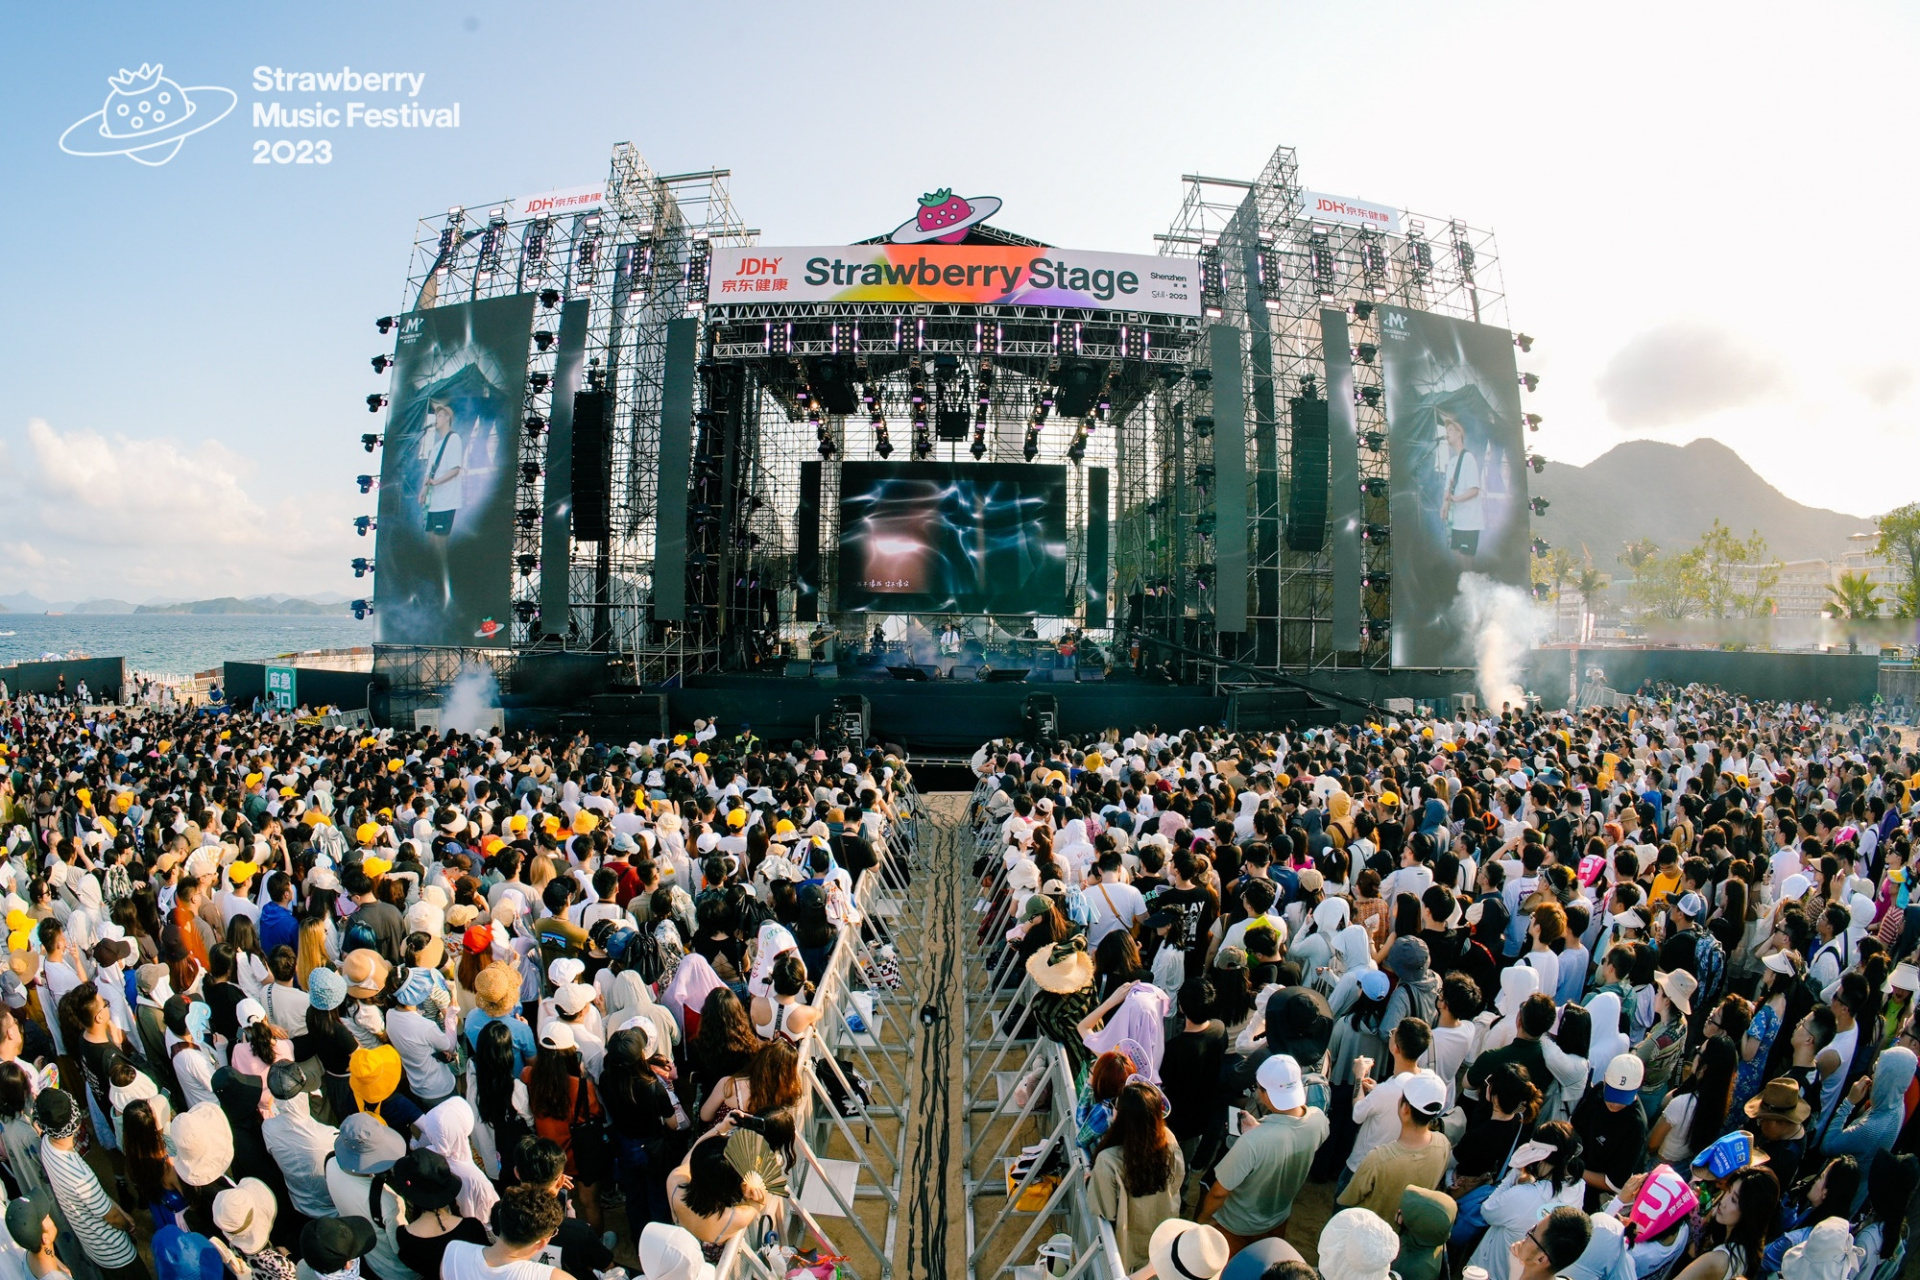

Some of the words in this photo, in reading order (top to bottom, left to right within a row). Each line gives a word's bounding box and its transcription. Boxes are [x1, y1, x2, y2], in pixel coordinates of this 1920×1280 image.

[525, 197, 555, 213] JDH
[555, 192, 602, 208] 京东健康
[1316, 198, 1346, 215] JDH
[1347, 206, 1390, 223] 京东健康
[736, 257, 783, 276] JDH
[804, 257, 1022, 294] Strawberry
[1028, 257, 1139, 300] Stage
[1150, 271, 1187, 282] Shenzhen
[721, 277, 789, 293] 京东健康
[1168, 292, 1188, 300] 2023
[1181, 900, 1205, 914] LAY
[1619, 1076, 1627, 1086] B
